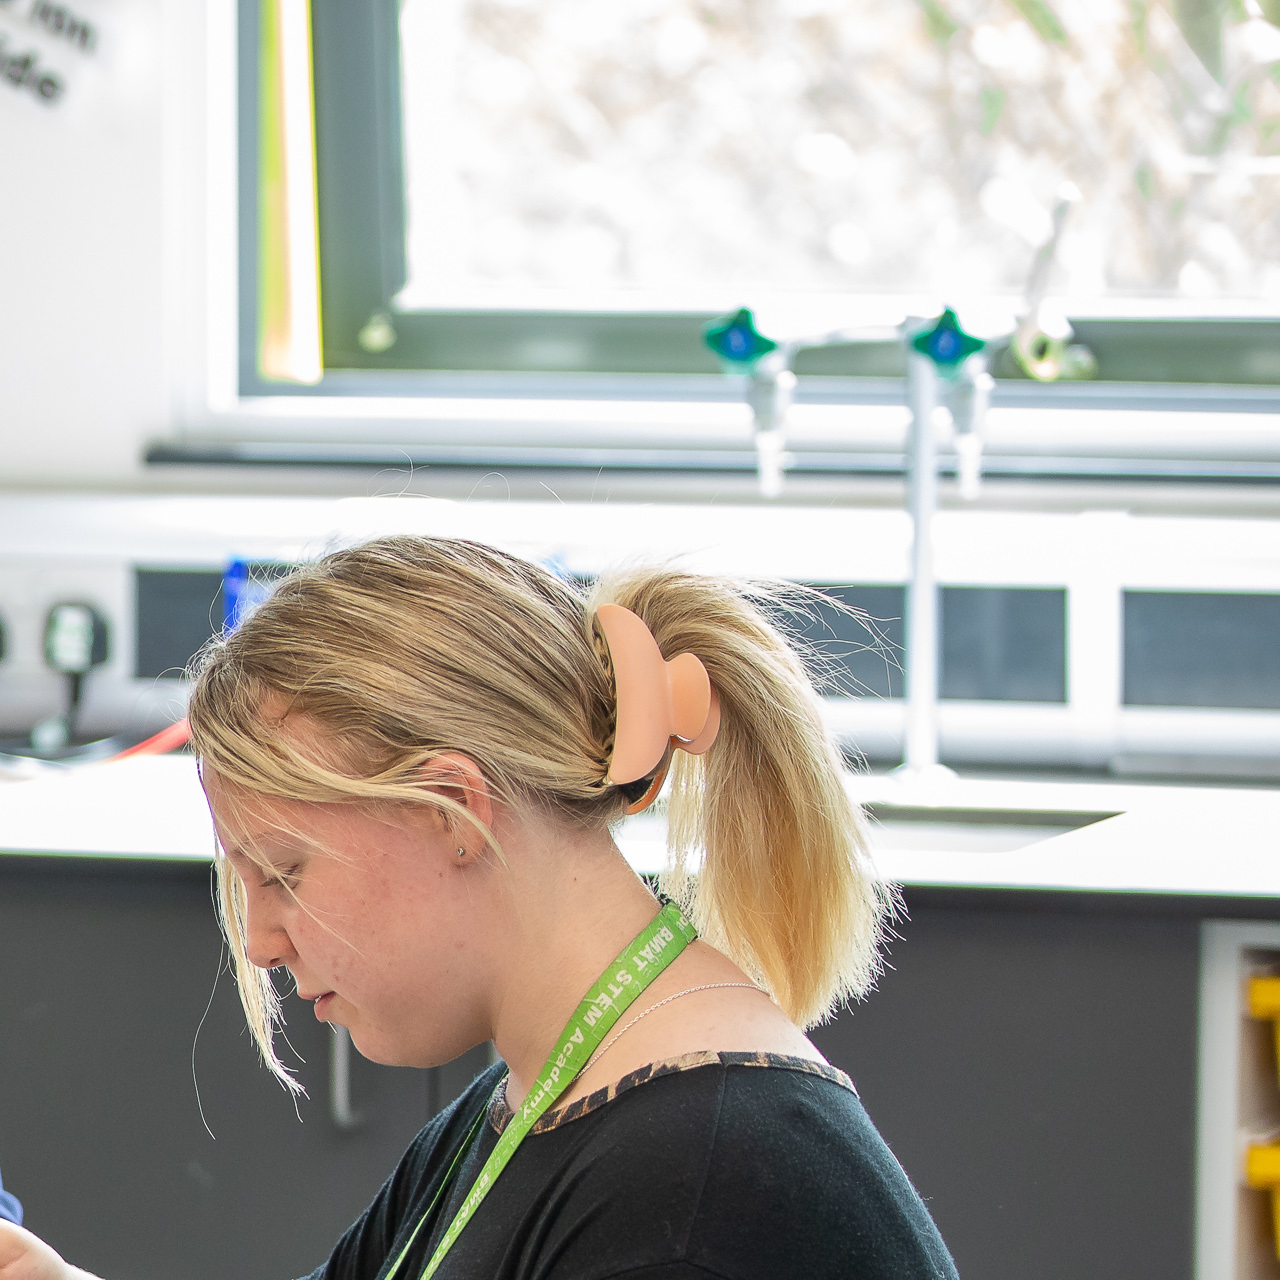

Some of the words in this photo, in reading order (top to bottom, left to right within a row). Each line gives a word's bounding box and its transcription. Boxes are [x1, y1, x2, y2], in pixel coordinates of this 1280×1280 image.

[632, 926, 674, 972] BMAT
[583, 969, 632, 1027] STEM
[523, 1026, 584, 1120] Academy
